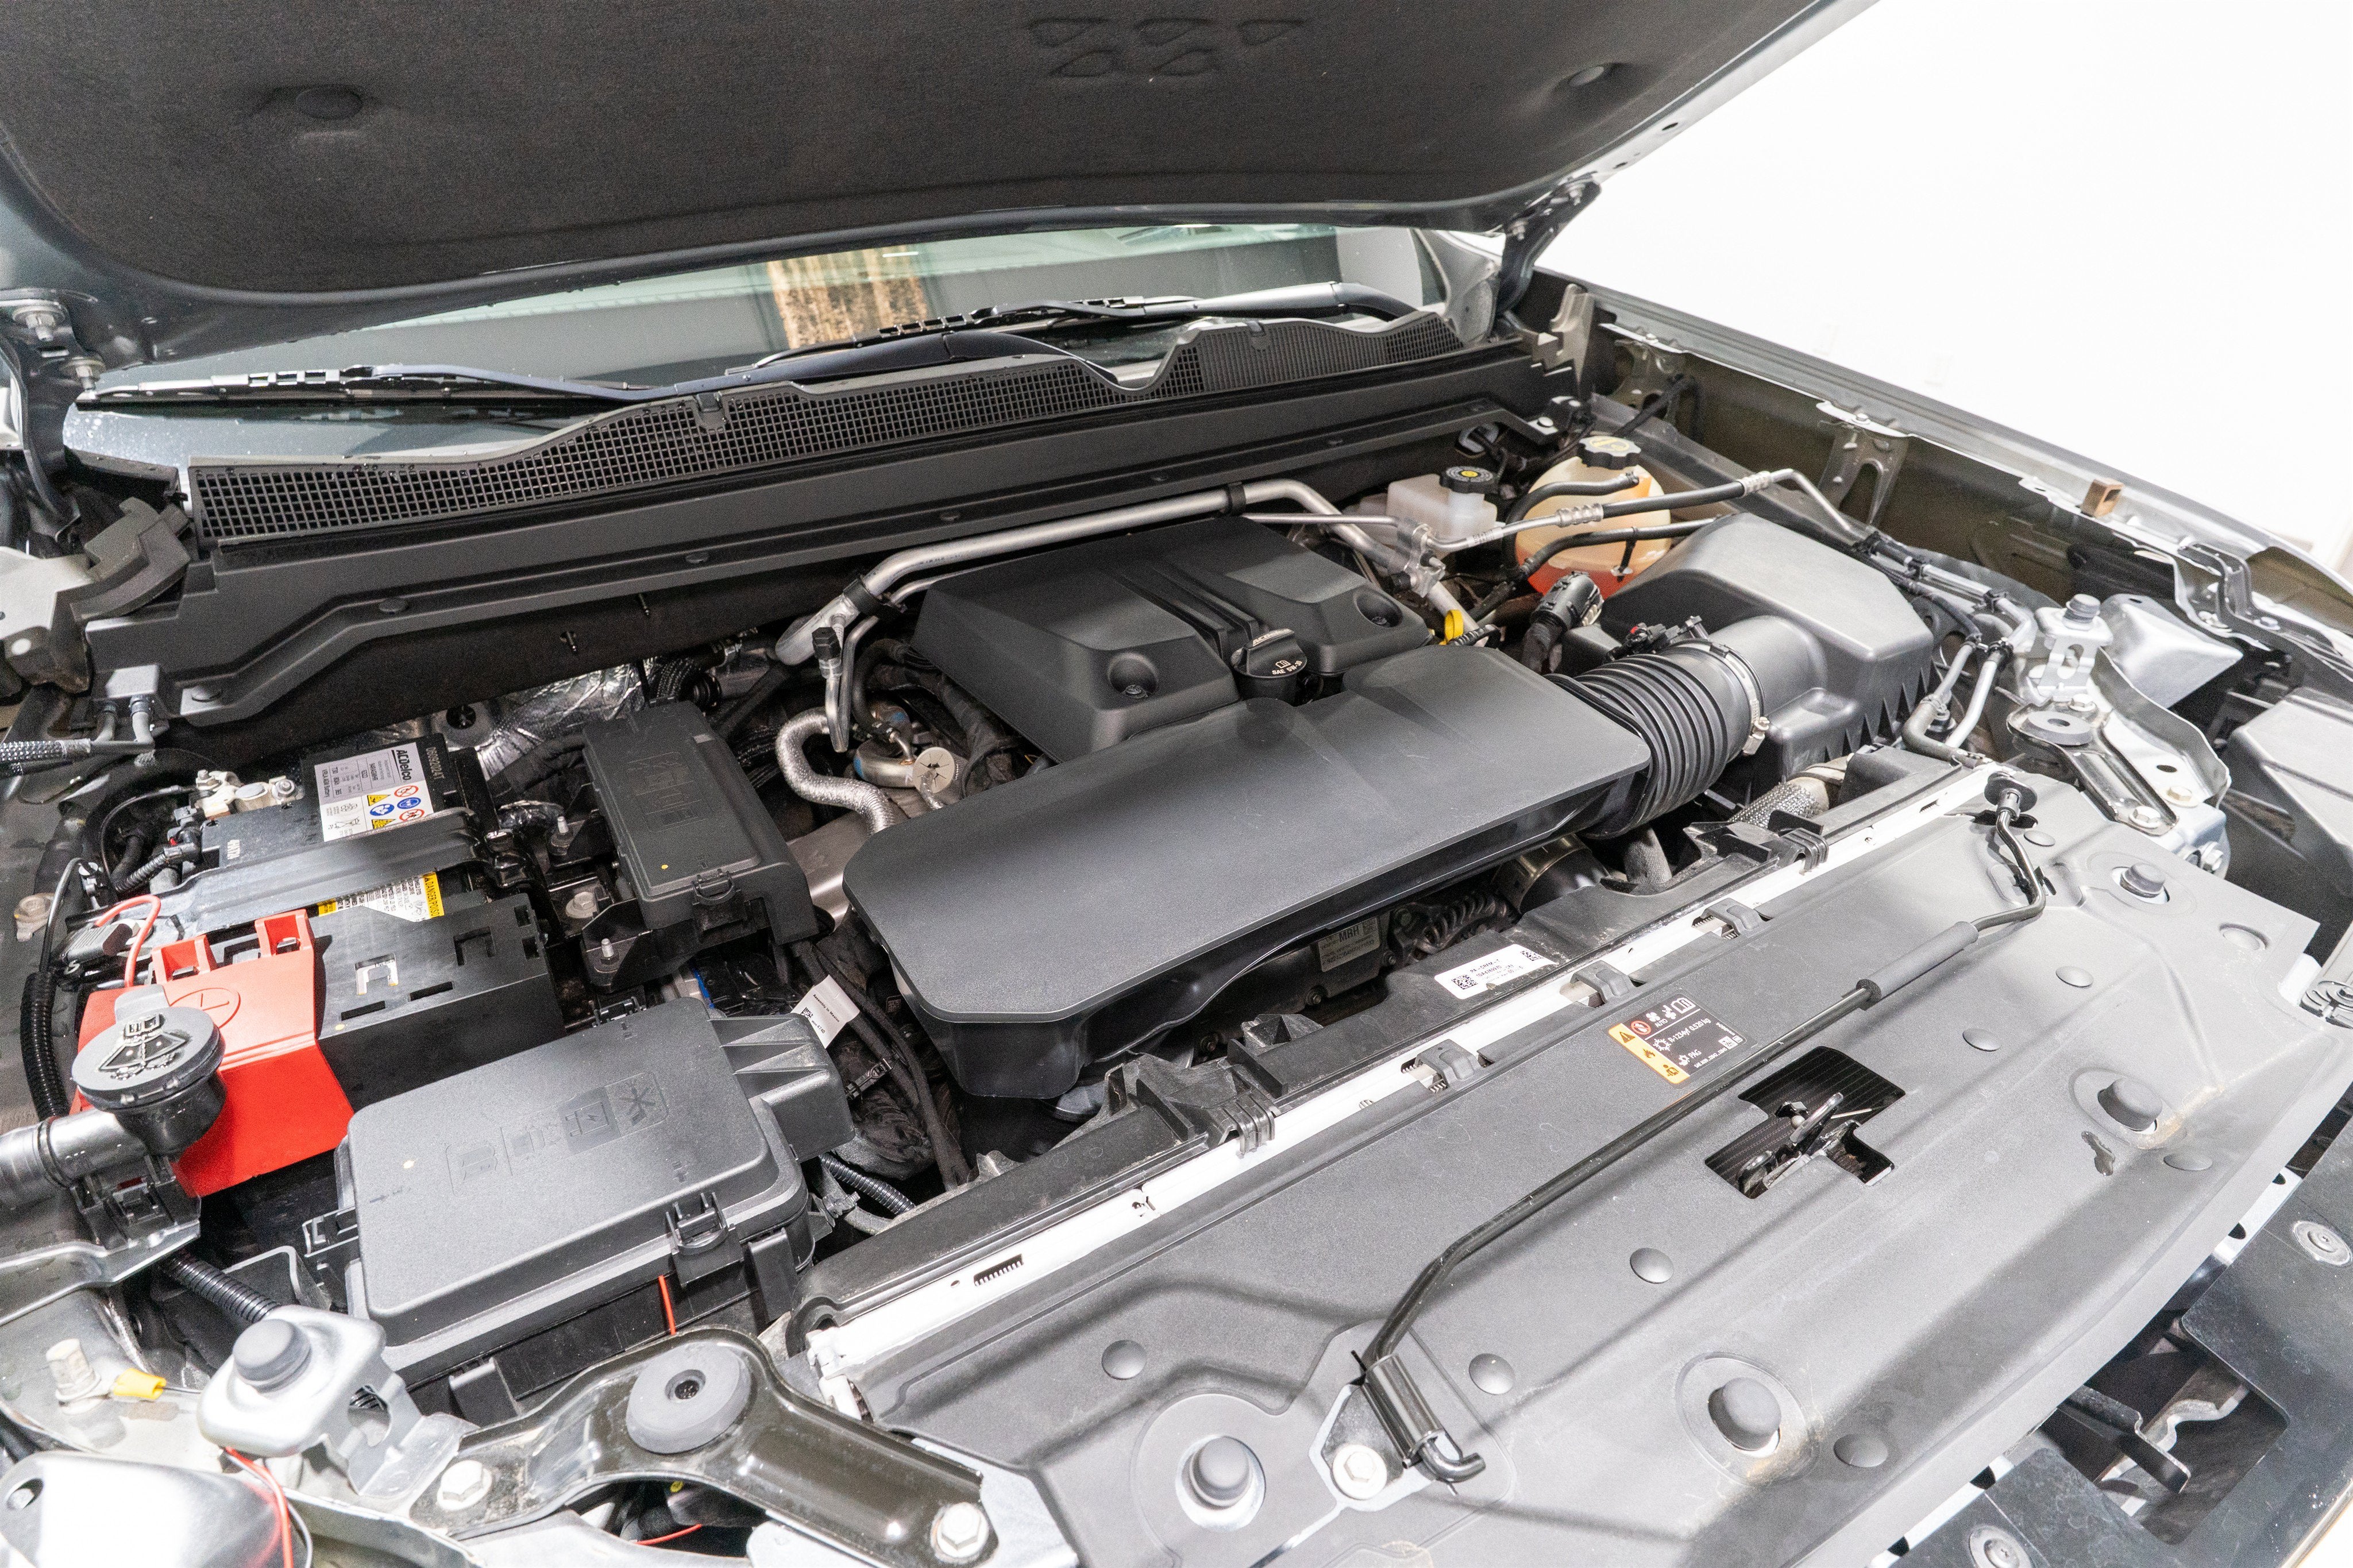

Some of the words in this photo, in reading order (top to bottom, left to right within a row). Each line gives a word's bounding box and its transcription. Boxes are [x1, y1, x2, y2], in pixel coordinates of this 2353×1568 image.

[1286, 661, 1302, 672] 5W-30
[396, 750, 412, 781] ACDelco
[813, 994, 826, 1009] Assembly
[830, 1011, 840, 1022] Mexico
[1654, 1018, 1668, 1028] AUTO
[817, 1025, 826, 1034] 4740
[1668, 1027, 1691, 1043] R-1234yf
[1689, 1019, 1704, 1032] 0.520
[1687, 1049, 1702, 1059] PAG
